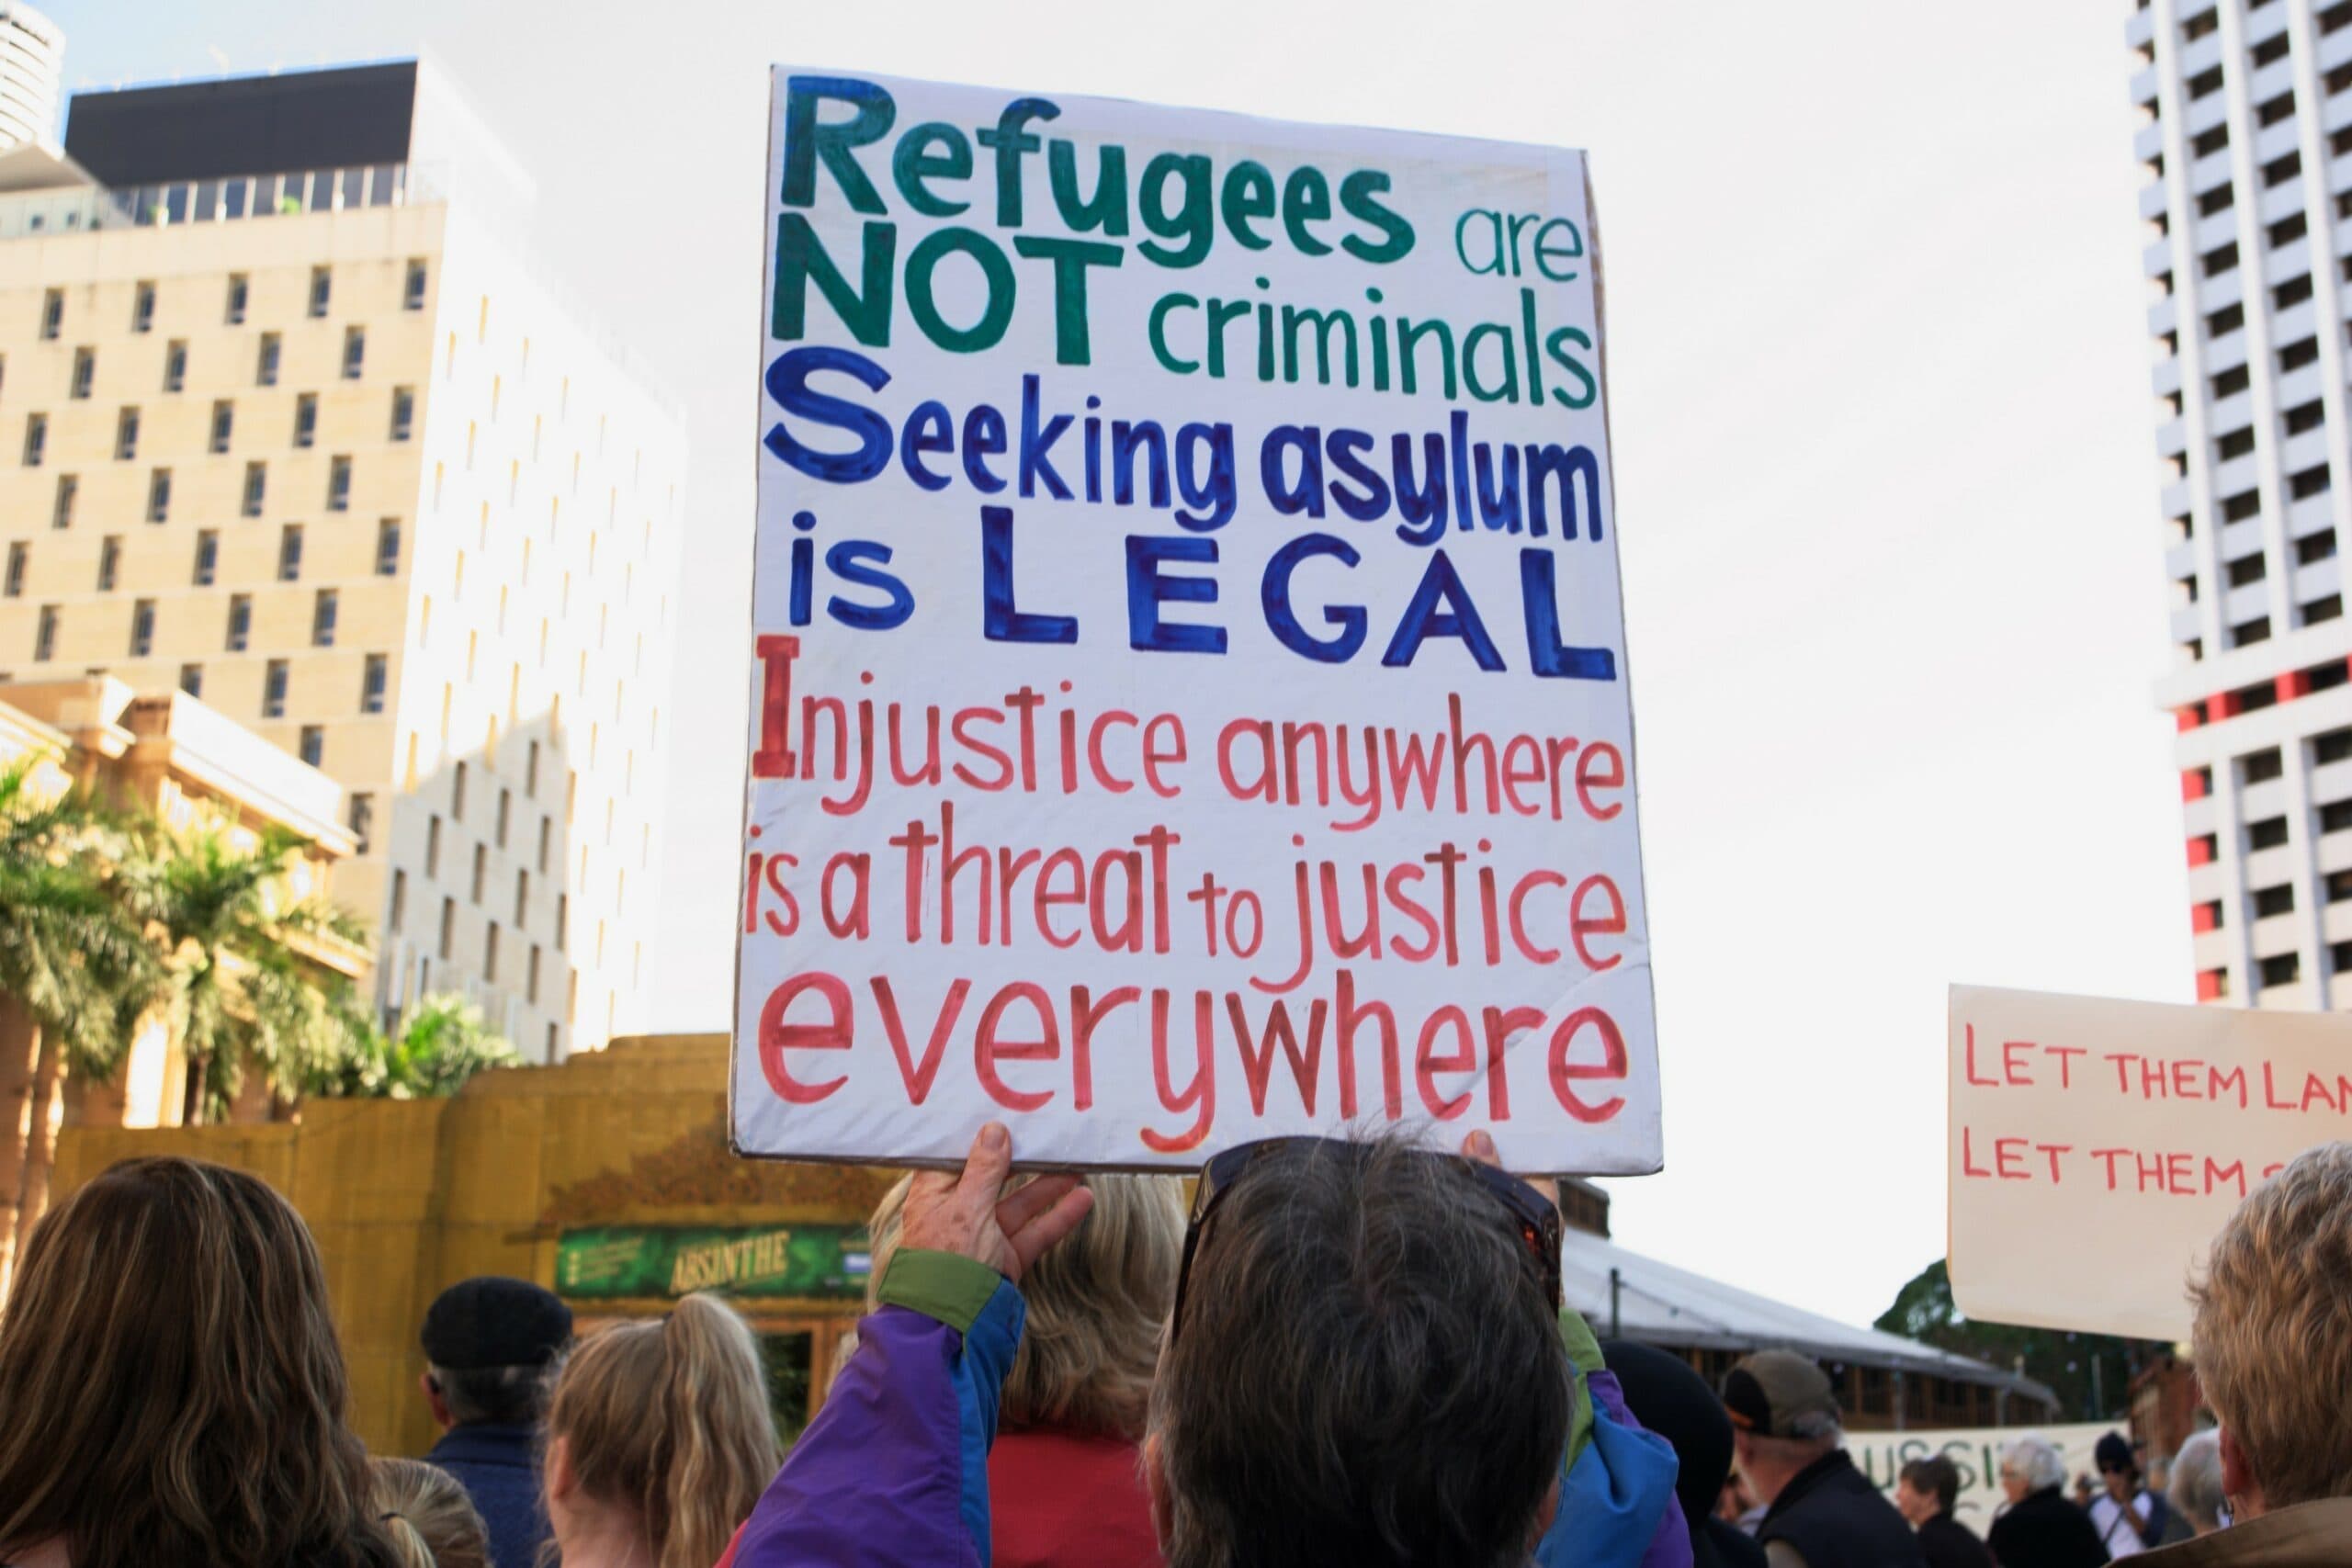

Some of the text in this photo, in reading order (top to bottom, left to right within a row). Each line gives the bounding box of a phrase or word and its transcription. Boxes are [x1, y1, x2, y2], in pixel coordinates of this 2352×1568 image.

[781, 75, 1583, 281] Refugees are
[771, 212, 1597, 410] NOT criminals
[763, 346, 1602, 547] Seeking asylum
[790, 505, 1616, 681] is LEGAL
[752, 635, 1624, 832] Injustice anywhere
[745, 800, 1627, 994] is a threat to justice
[758, 968, 1627, 1153] everywhere
[1964, 1021, 2087, 1089] LET
[2104, 1054, 2248, 1109] THEM
[1963, 1126, 2246, 1198] LET THEM
[669, 1230, 791, 1294] ABSINTHE
